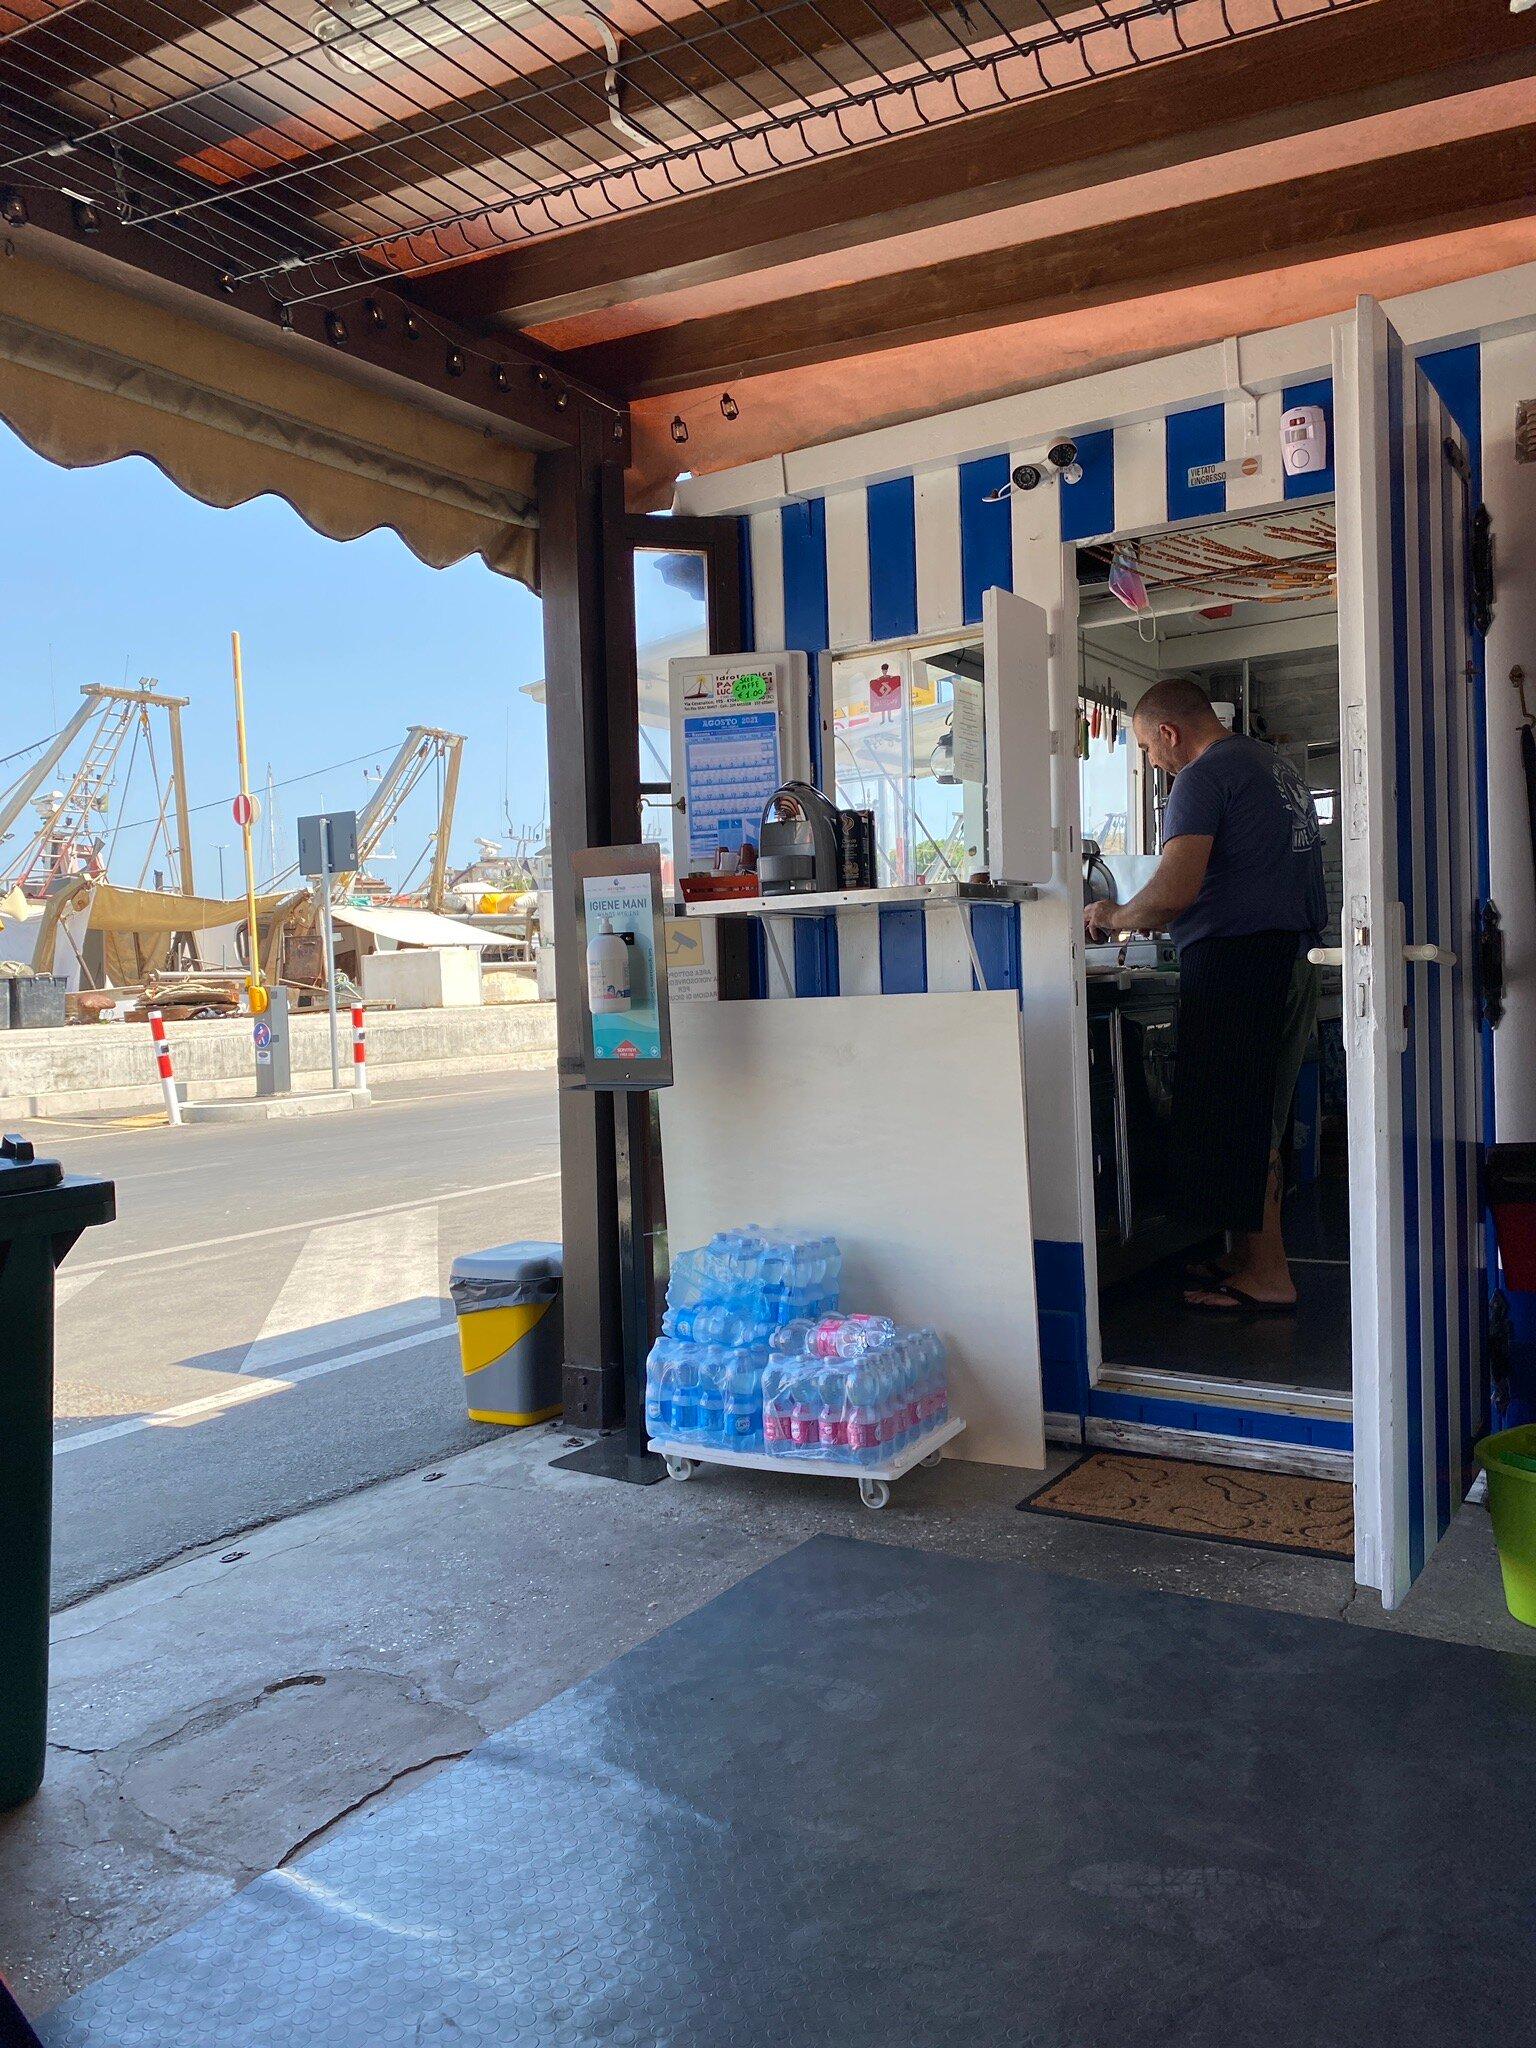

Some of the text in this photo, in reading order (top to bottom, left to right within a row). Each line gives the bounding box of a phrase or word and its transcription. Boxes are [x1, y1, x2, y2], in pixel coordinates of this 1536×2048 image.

[1191, 465, 1215, 477] VIETATO
[702, 716, 759, 728] AGOSTO 2021
[589, 898, 647, 911] IGIENE MANI
